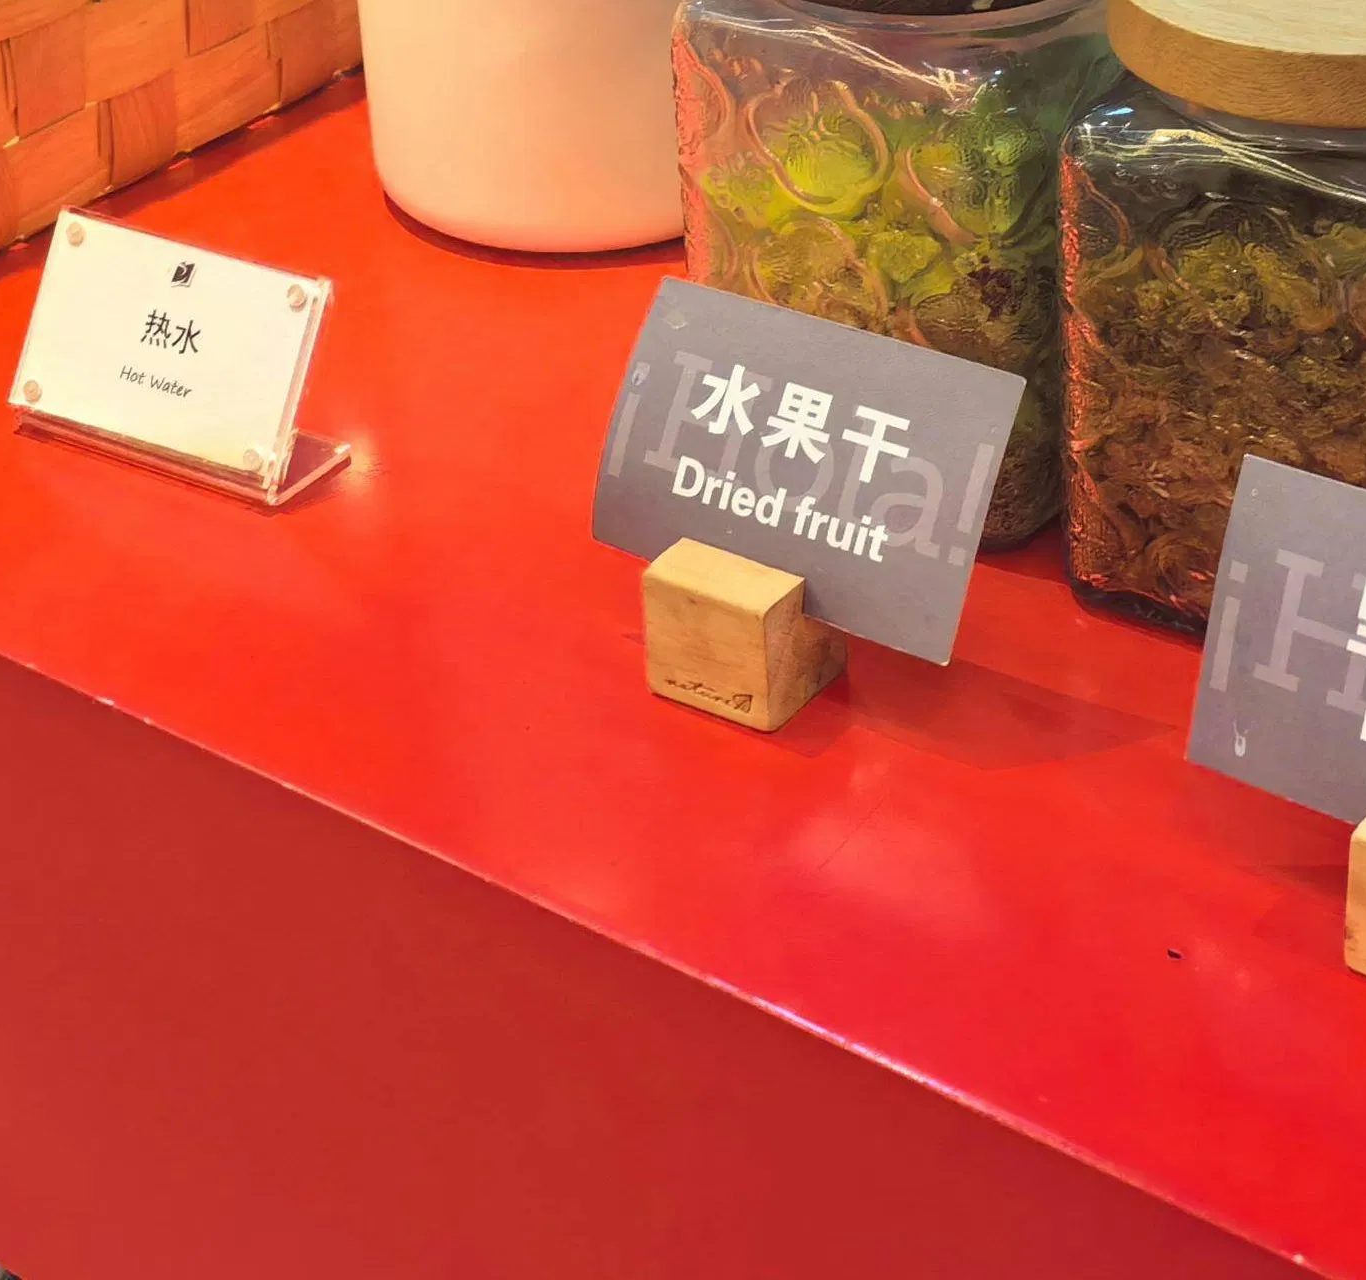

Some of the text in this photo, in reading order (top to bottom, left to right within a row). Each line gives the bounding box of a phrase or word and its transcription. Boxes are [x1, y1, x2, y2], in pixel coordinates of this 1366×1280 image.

[140, 308, 202, 355] 热水
[119, 365, 193, 398] Hot Water
[690, 363, 911, 484] 水果干
[671, 455, 890, 563] Dried fruit
